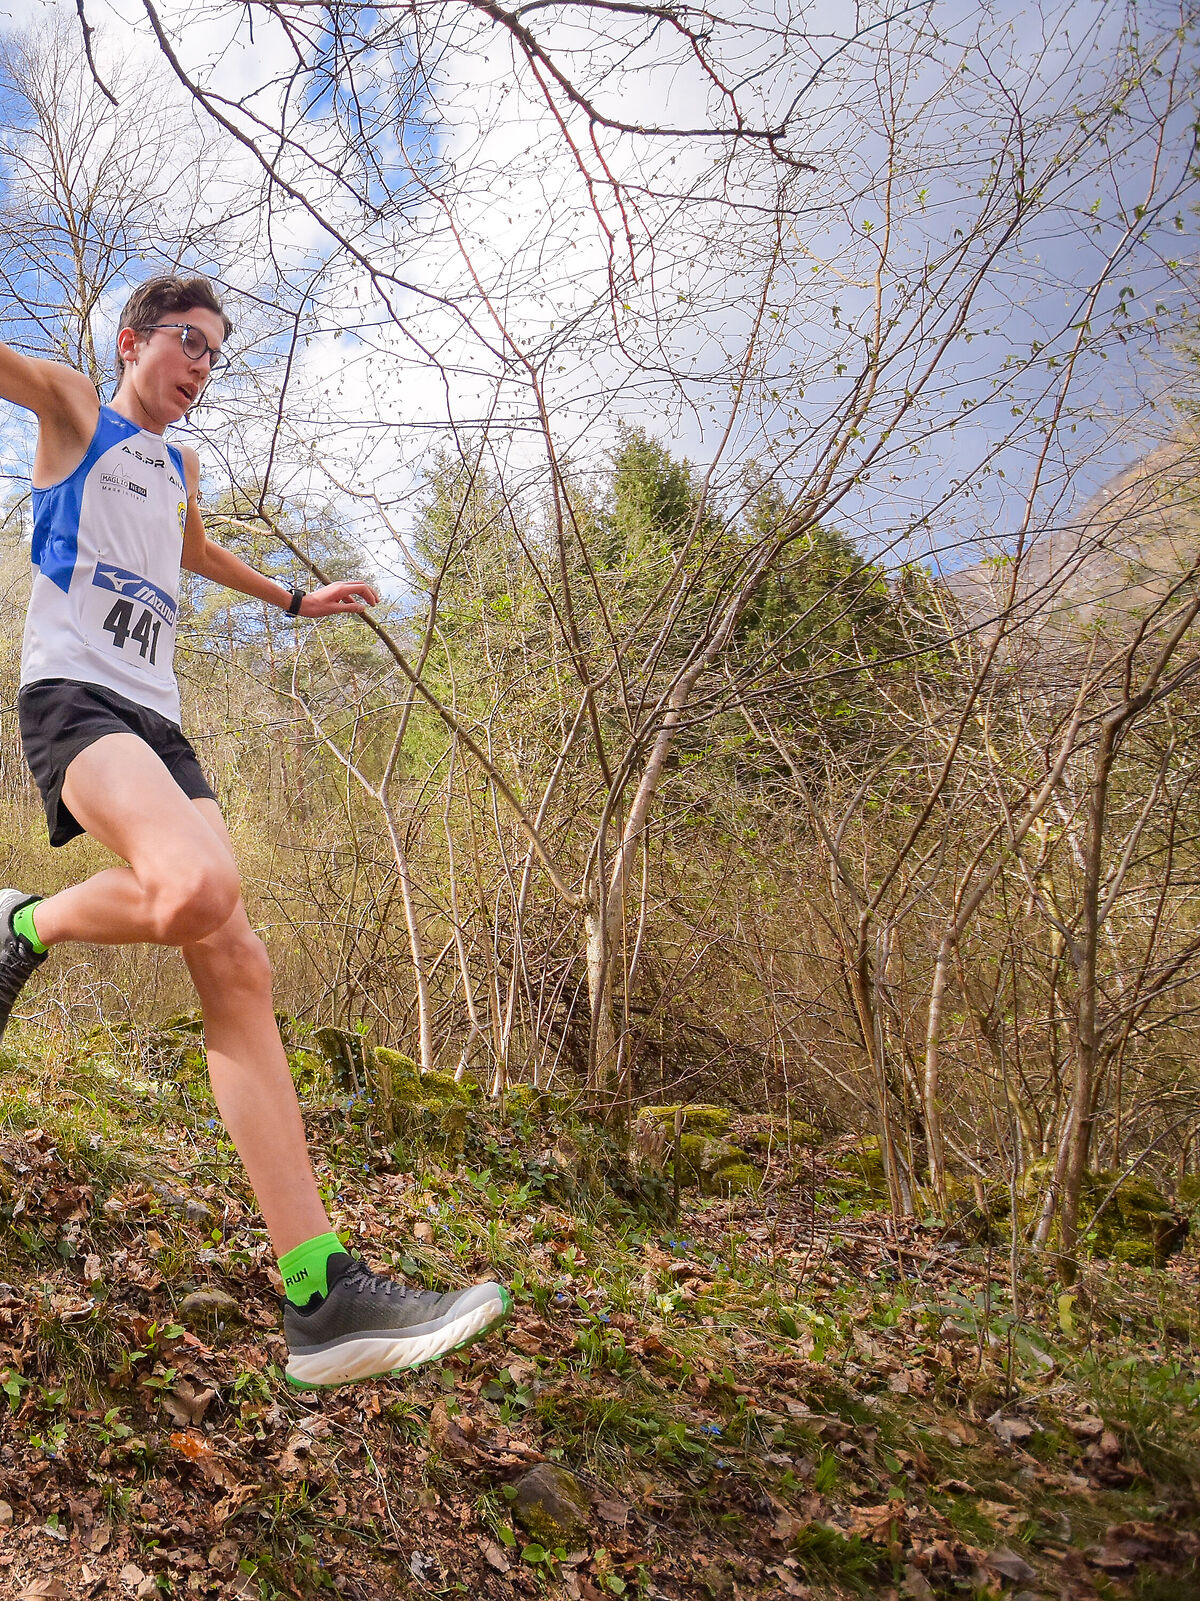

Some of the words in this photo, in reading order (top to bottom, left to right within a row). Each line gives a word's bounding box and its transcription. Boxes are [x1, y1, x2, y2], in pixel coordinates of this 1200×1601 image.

[102, 475, 128, 488] MAGLIO
[102, 598, 161, 666] 441
[285, 1267, 309, 1288] RUN
